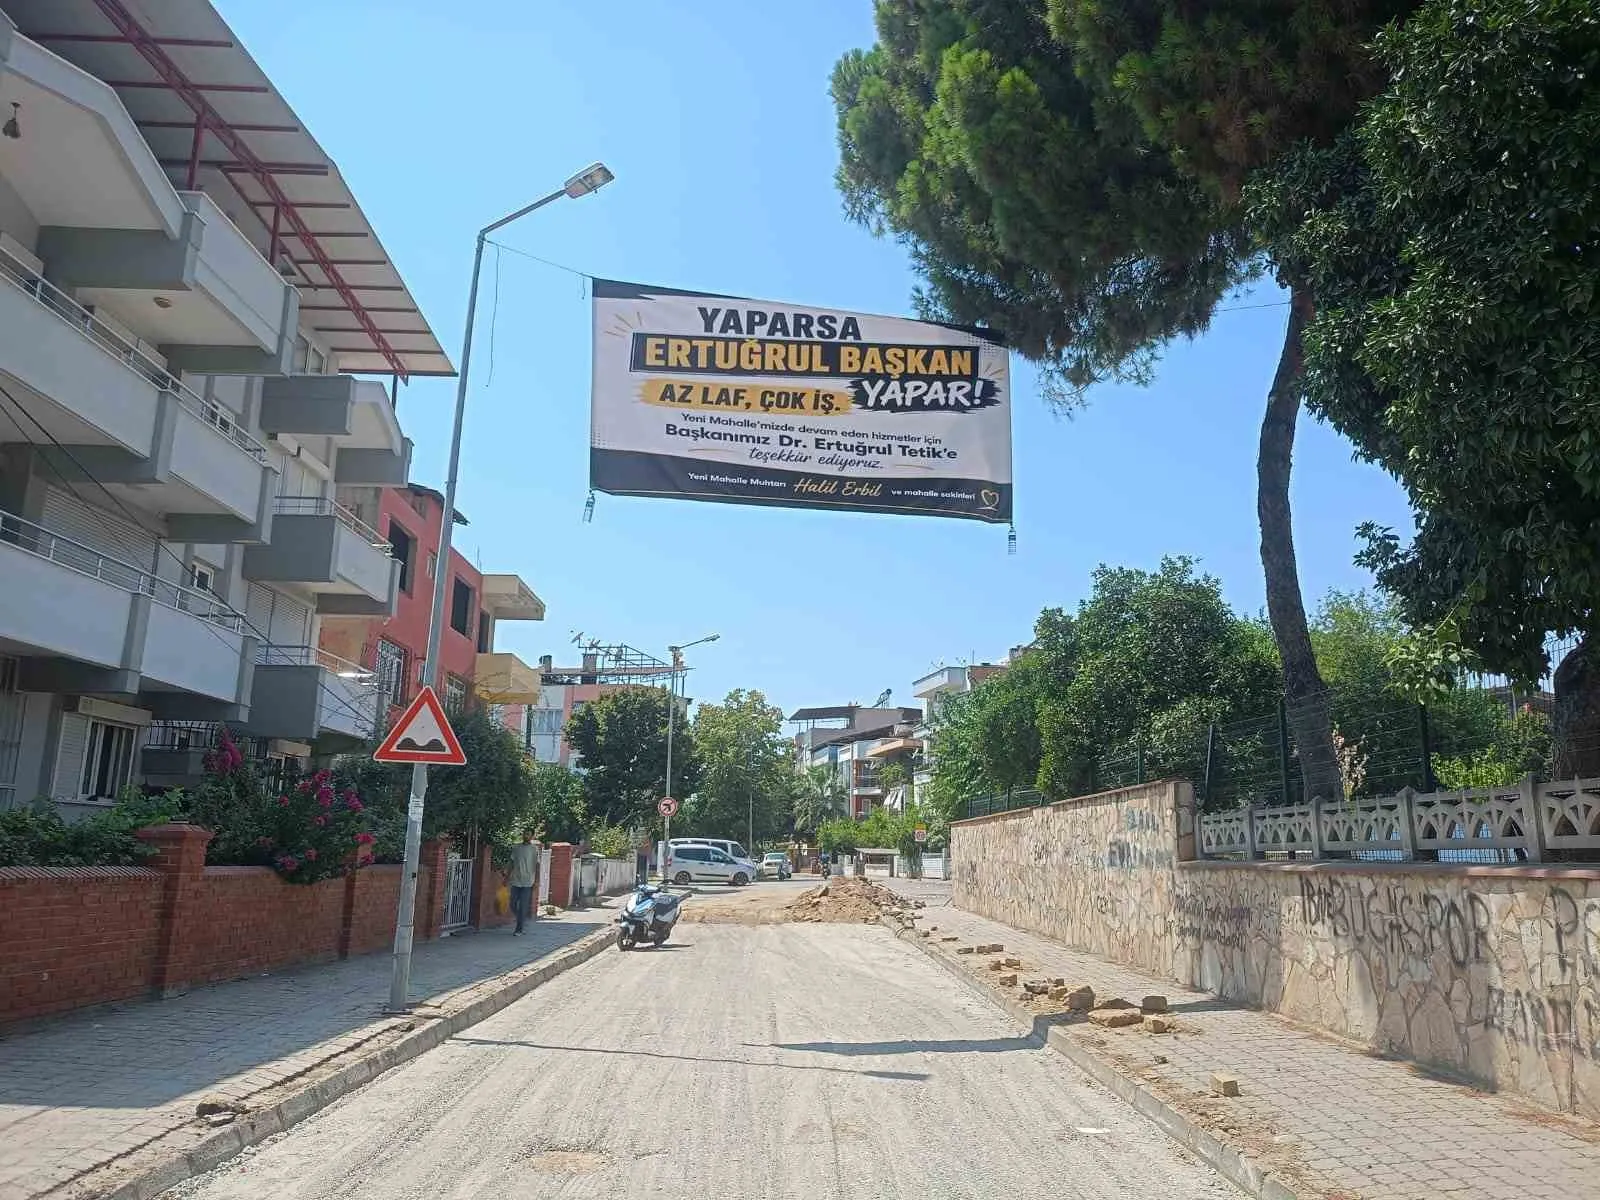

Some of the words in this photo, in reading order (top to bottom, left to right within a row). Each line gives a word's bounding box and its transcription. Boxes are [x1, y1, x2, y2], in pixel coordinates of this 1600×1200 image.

[697, 307, 862, 341] YAPARSA
[645, 337, 830, 374] ERTUĞRUL
[840, 345, 972, 379] BAŞKAN
[659, 383, 694, 404] AZ
[701, 386, 752, 409] LAF,
[760, 390, 807, 411] ÇOK
[813, 389, 841, 415] İŞ.
[861, 379, 984, 408] YAPAR!
[665, 423, 771, 446] Başkanımız
[779, 434, 808, 449] Dr.
[814, 437, 893, 456] Ertuğrul
[898, 444, 958, 460] Tetik'e
[681, 412, 706, 424] Yeni
[709, 415, 795, 433] Mahalle'mizde
[798, 424, 837, 437] devam
[841, 429, 869, 440] eden
[872, 432, 922, 444] hizmetler
[924, 435, 942, 446] için
[750, 446, 812, 464] teşekkür
[817, 452, 884, 472] ediyoruz.
[687, 472, 708, 481] Yeni
[710, 474, 748, 485] Mahalle
[750, 478, 787, 488] Muhtarı
[793, 477, 839, 495] Halil
[841, 481, 883, 497] Erbil
[891, 488, 902, 496] ve
[904, 488, 939, 498] mahalle
[940, 491, 976, 501] sakinleri
